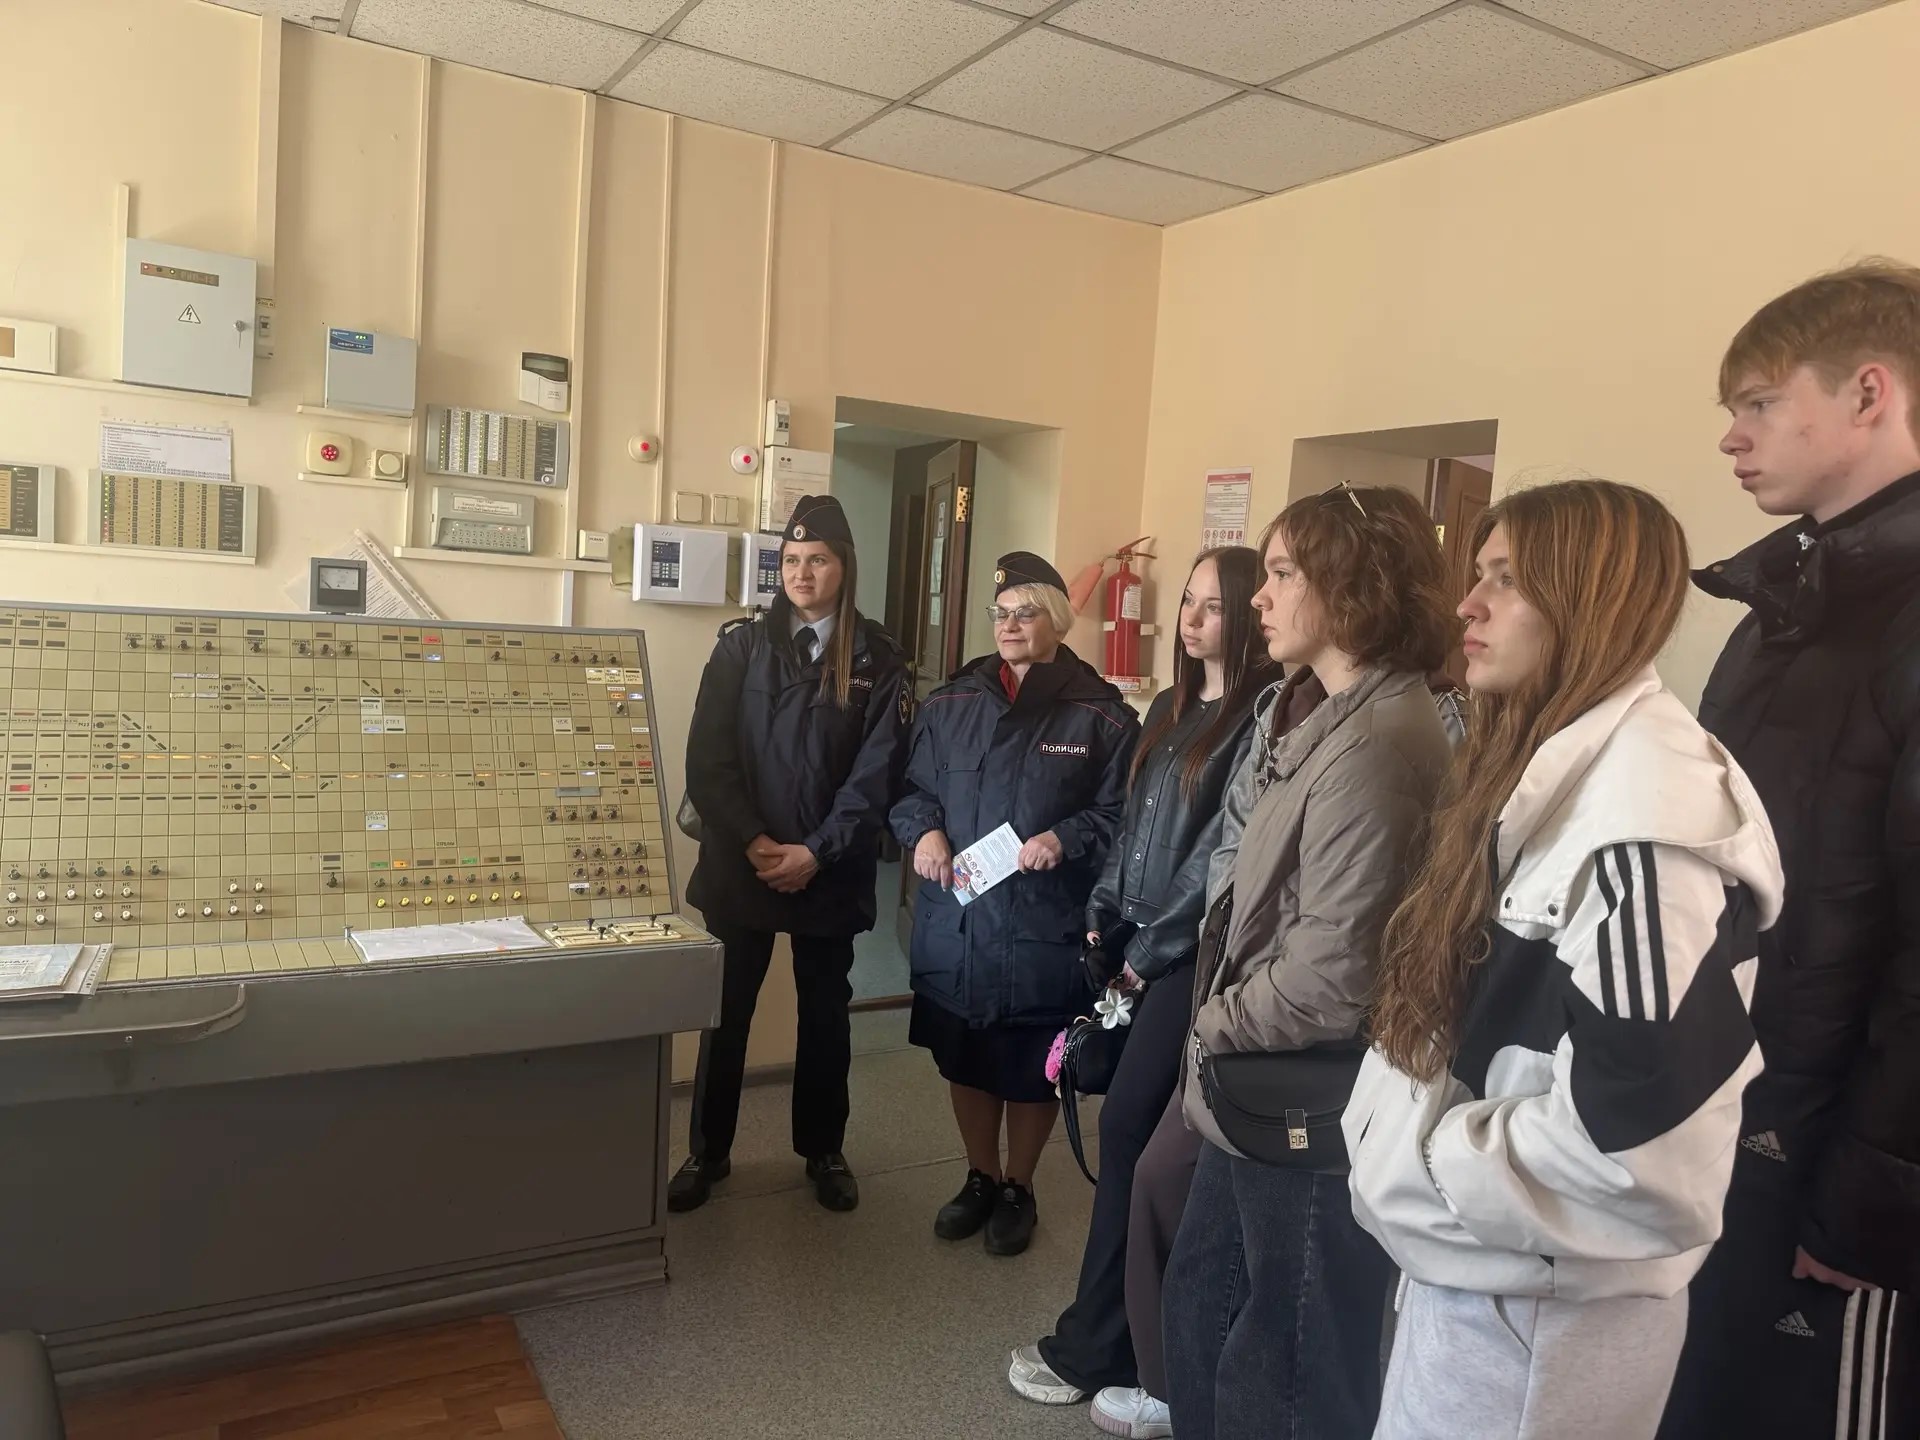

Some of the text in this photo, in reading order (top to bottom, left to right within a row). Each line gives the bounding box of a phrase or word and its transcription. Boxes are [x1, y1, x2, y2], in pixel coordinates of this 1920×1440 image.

[850, 678, 873, 688] ЛИЦИЯ
[1042, 744, 1086, 755] ПОЛИЦИЯ
[1741, 1139, 1786, 1162] adidas
[1775, 1322, 1815, 1337] adidas
